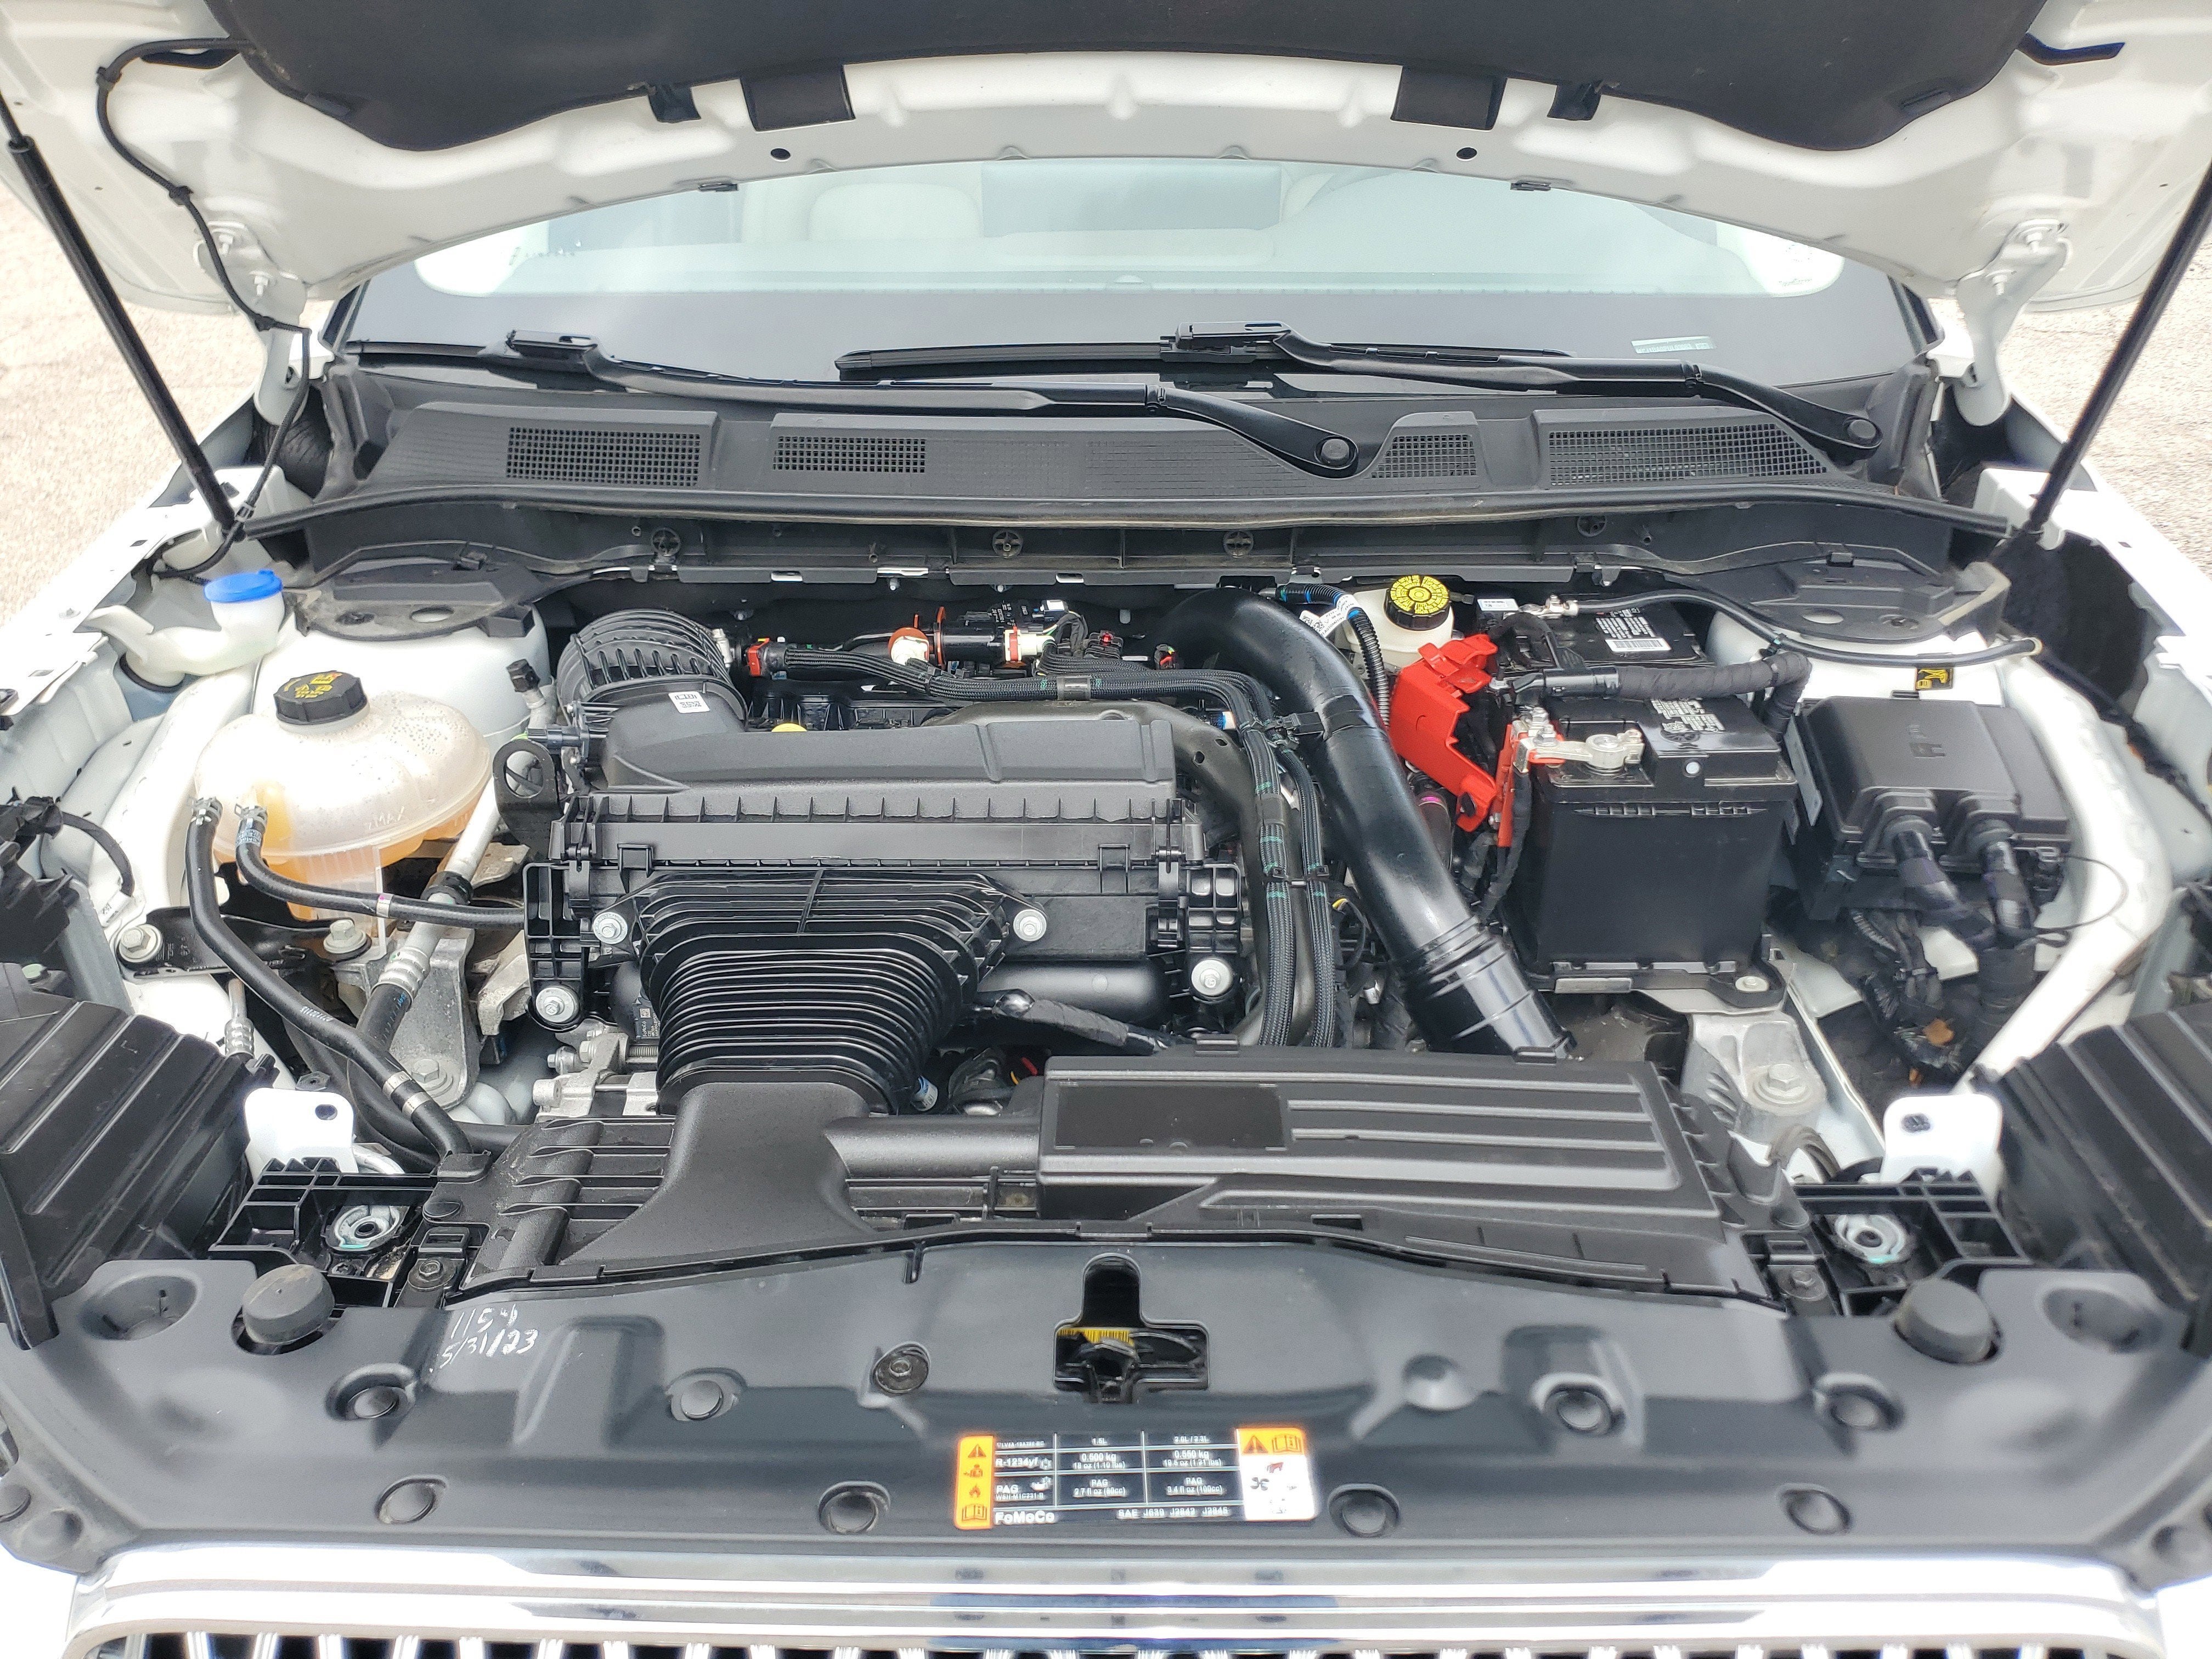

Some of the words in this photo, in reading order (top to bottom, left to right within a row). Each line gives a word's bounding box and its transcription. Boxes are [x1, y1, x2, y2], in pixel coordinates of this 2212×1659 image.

[439, 1328, 538, 1369] 5/31/23
[1081, 1453, 1104, 1462] 0.500
[1105, 1452, 1116, 1462] kg
[1174, 1450, 1197, 1459] 0.550
[1199, 1449, 1209, 1459] kg
[995, 1457, 1039, 1468] R-1234yf
[996, 1484, 1019, 1494] PAG
[995, 1510, 1055, 1524] FoMoCo
[1118, 1509, 1138, 1517] SAE
